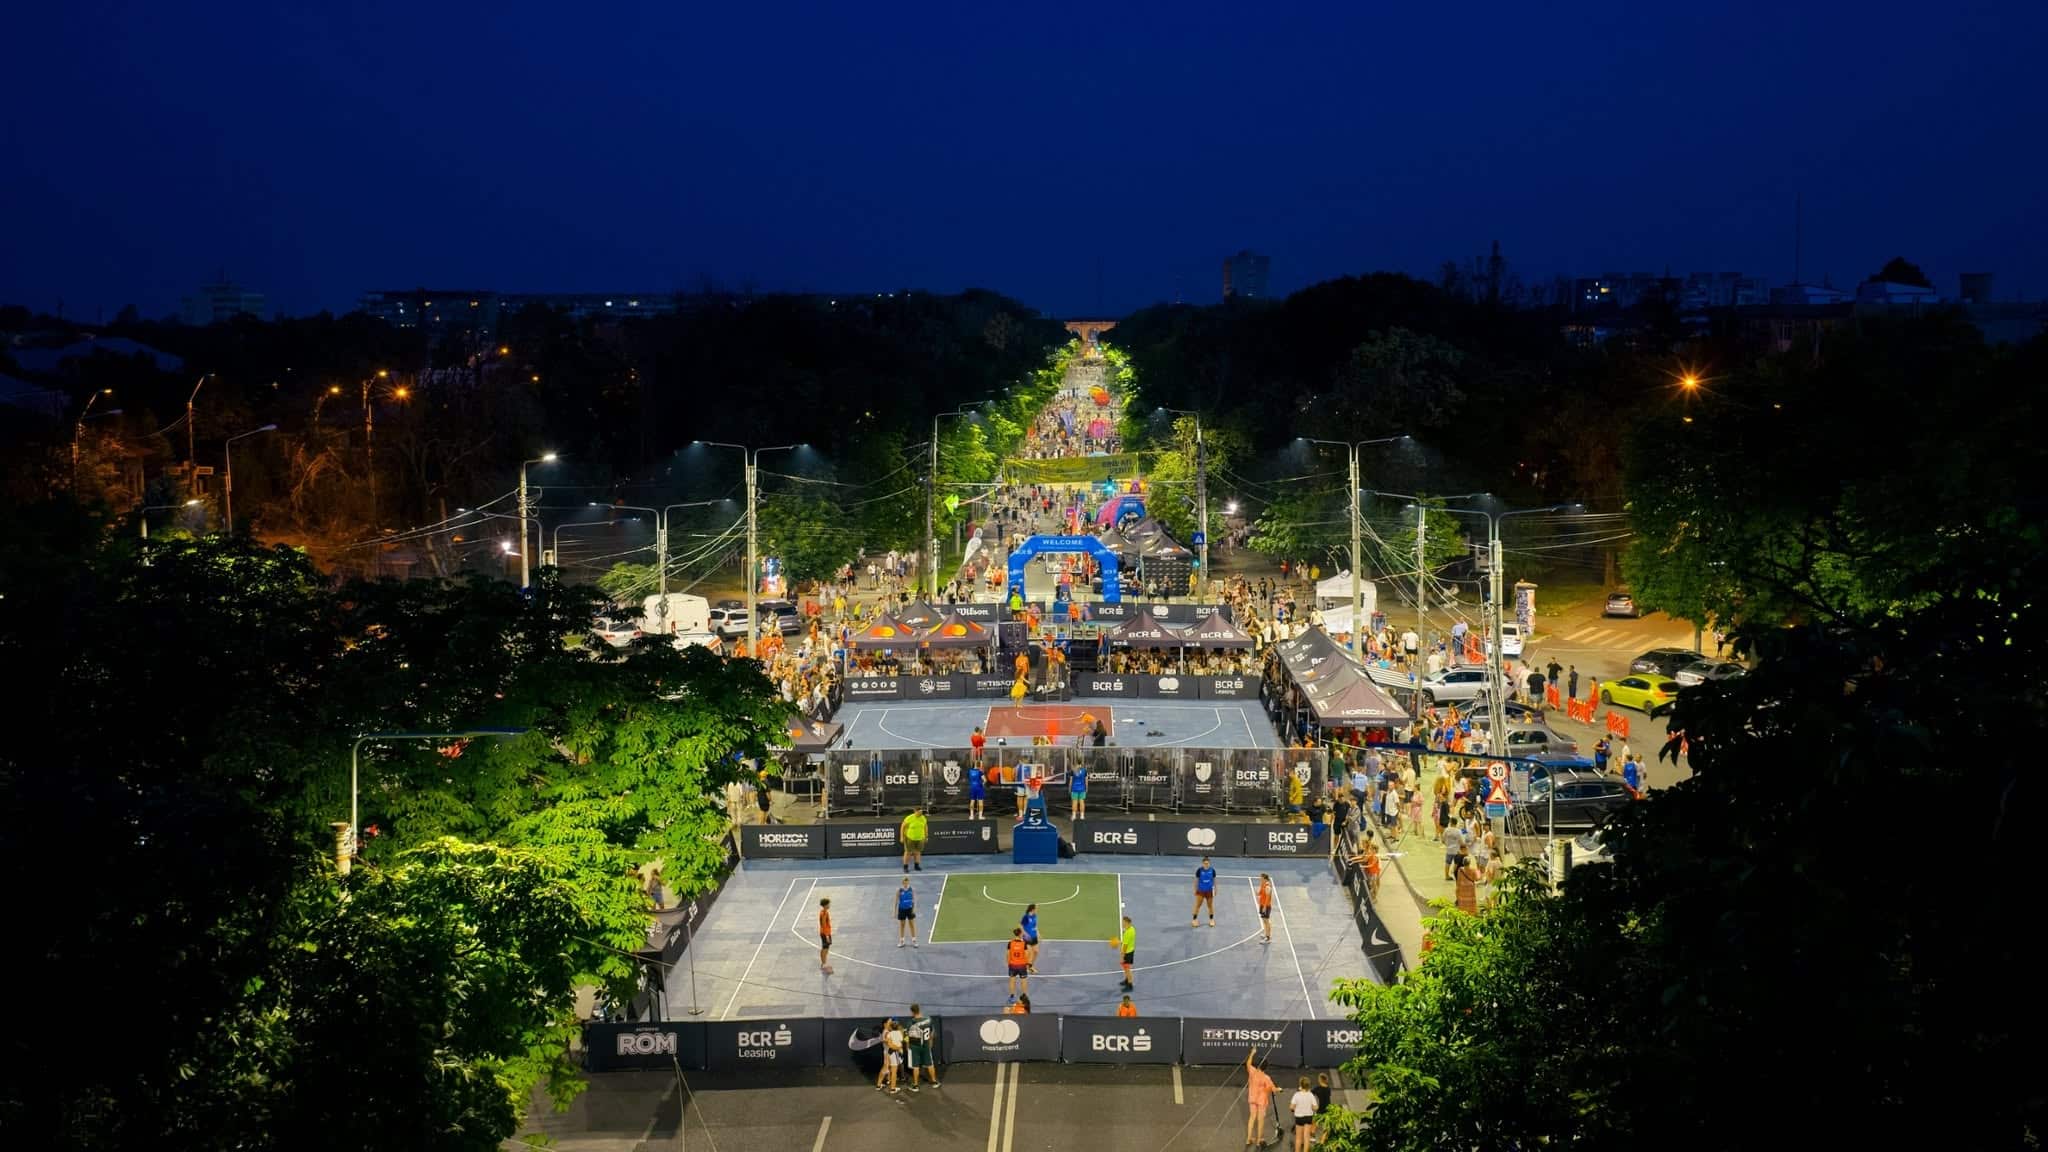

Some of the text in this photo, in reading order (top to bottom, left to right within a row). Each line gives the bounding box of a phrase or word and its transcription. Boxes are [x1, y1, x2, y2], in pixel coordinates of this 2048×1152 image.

[955, 607, 990, 616] Wilson
[1098, 607, 1115, 615] BCR
[1092, 681, 1113, 691] BCR
[1215, 680, 1233, 689] BCR
[1236, 770, 1258, 780] BCR
[1492, 766, 1504, 777] 30
[885, 775, 907, 785] BCR
[759, 833, 809, 843] HORIZON
[1093, 831, 1122, 844] BCR
[1268, 831, 1294, 843] BCR
[1268, 843, 1297, 853] Leasing
[738, 1031, 773, 1046] BCR
[1225, 1030, 1282, 1041] TISSOT
[617, 1032, 678, 1055] ROM
[1092, 1034, 1130, 1051] BCR
[738, 1048, 776, 1059] Leasing
